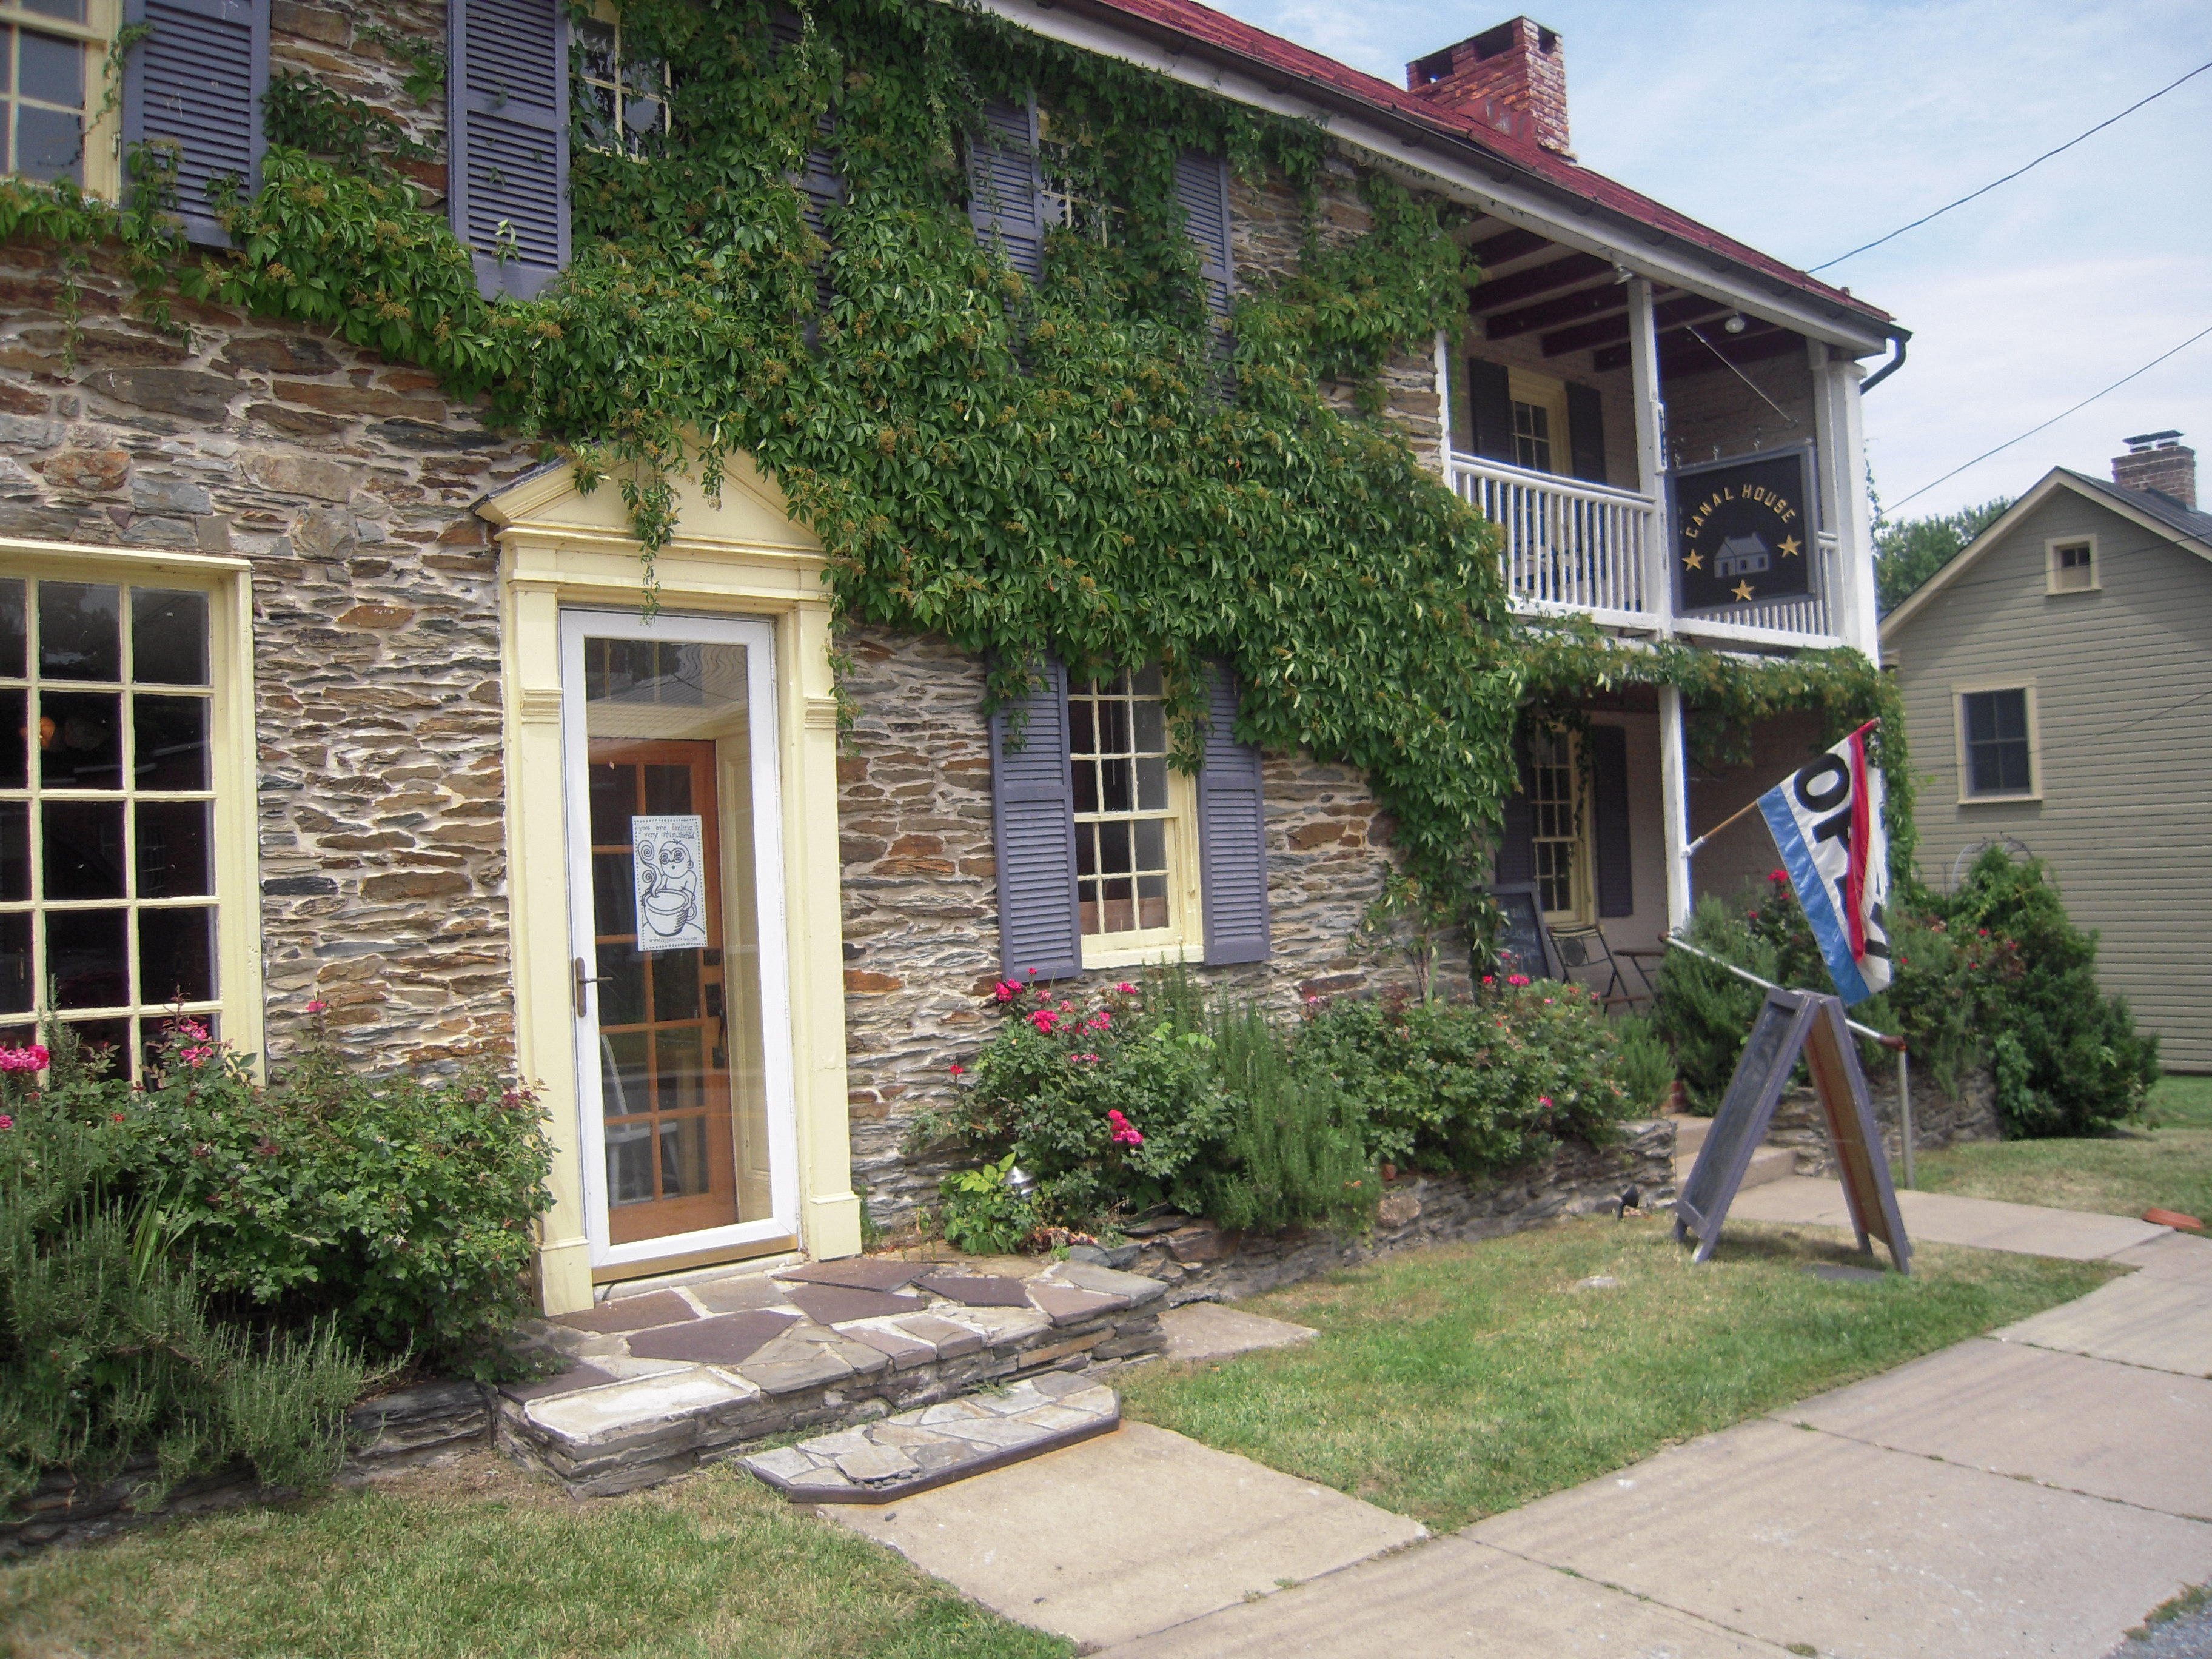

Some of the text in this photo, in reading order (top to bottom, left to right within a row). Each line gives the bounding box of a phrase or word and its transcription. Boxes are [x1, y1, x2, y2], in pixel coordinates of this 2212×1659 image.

[1685, 484, 1795, 538] CANAL HOUSE
[644, 833, 658, 842] very
